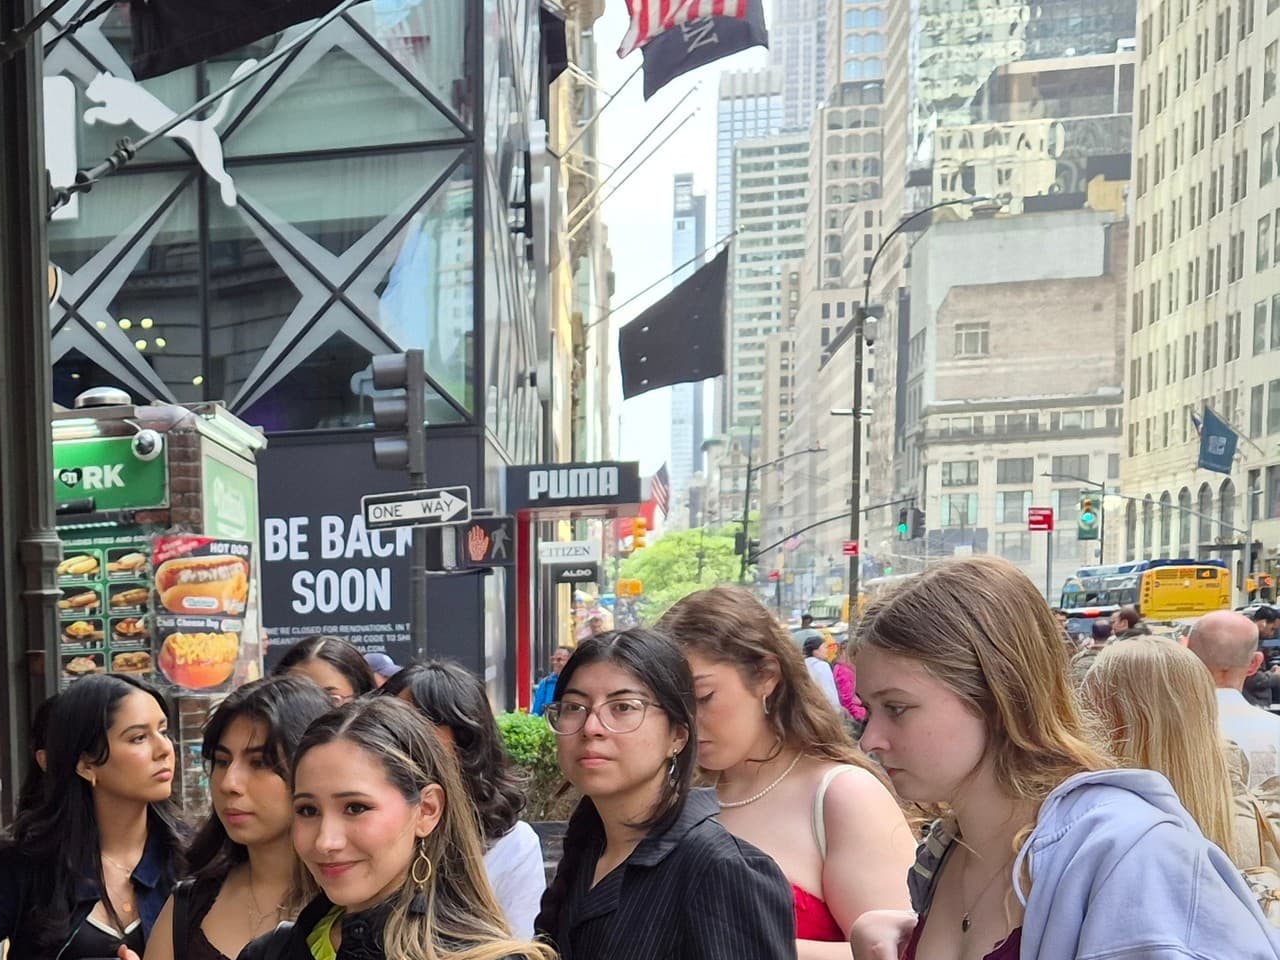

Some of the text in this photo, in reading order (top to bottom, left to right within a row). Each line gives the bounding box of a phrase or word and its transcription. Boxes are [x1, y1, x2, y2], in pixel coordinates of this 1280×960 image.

[528, 466, 619, 500] PUMA
[373, 499, 454, 520] ONE WAY
[264, 516, 310, 562] BE
[210, 543, 229, 553] HOT
[231, 544, 248, 555] DOG
[540, 546, 591, 558] CITIZEN
[561, 569, 592, 577] ALDO
[291, 567, 391, 614] SOON
[292, 625, 321, 634] CLOSED
[322, 624, 339, 633] FOR
[395, 623, 403, 631] IN
